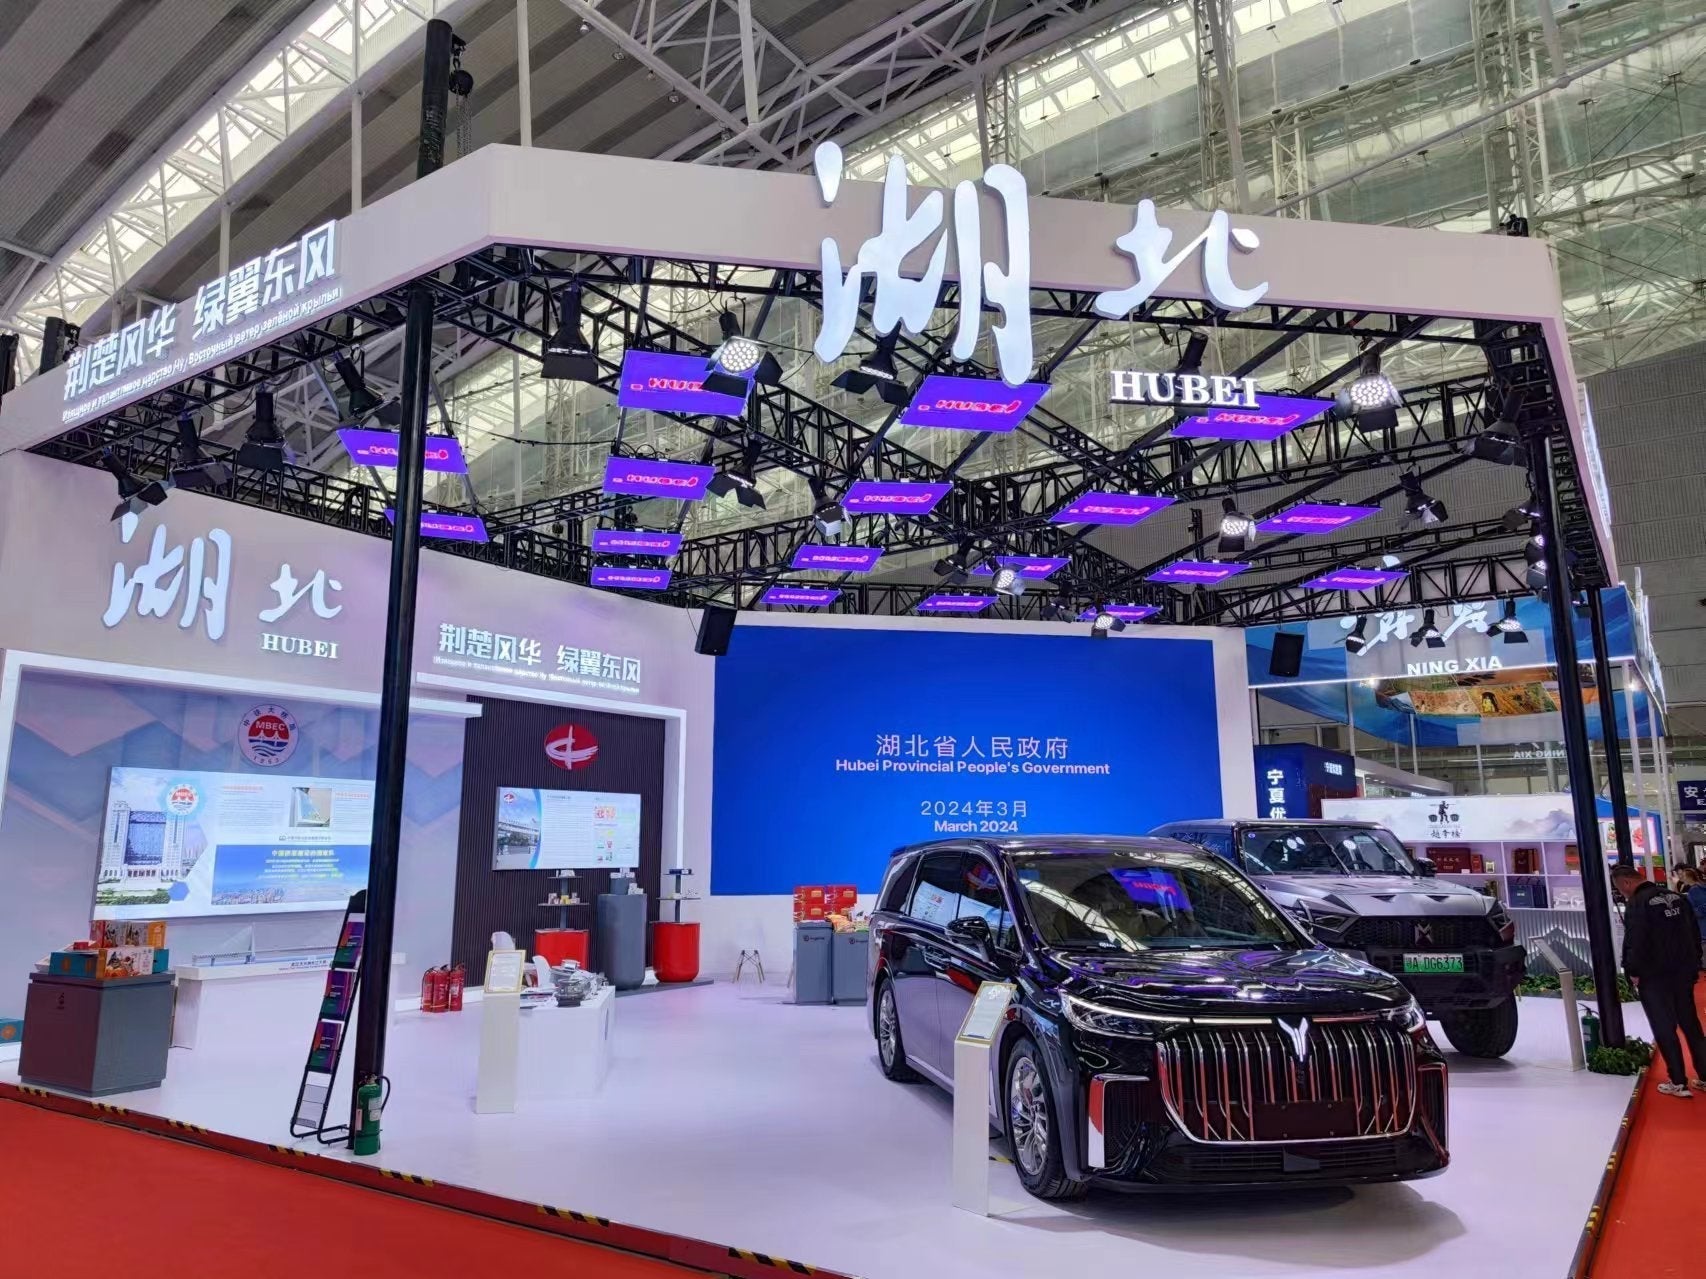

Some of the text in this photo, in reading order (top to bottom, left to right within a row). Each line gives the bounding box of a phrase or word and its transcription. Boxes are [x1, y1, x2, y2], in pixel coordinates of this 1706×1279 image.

[63, 219, 338, 401] 荆楚风华 绿翼东风
[1110, 370, 1261, 409] HUBEI
[261, 633, 339, 659] HUBEI
[439, 622, 542, 666] 荆楚风华
[556, 645, 641, 684] 绿翼东风
[1407, 655, 1503, 676] NING XIA
[255, 721, 286, 731] MBEC
[876, 734, 1069, 760] 湖北省人民政府
[835, 759, 1110, 775] Hubei Provincial People's Government
[920, 801, 1029, 818] 2024年3月
[934, 820, 1019, 833] March 2024
